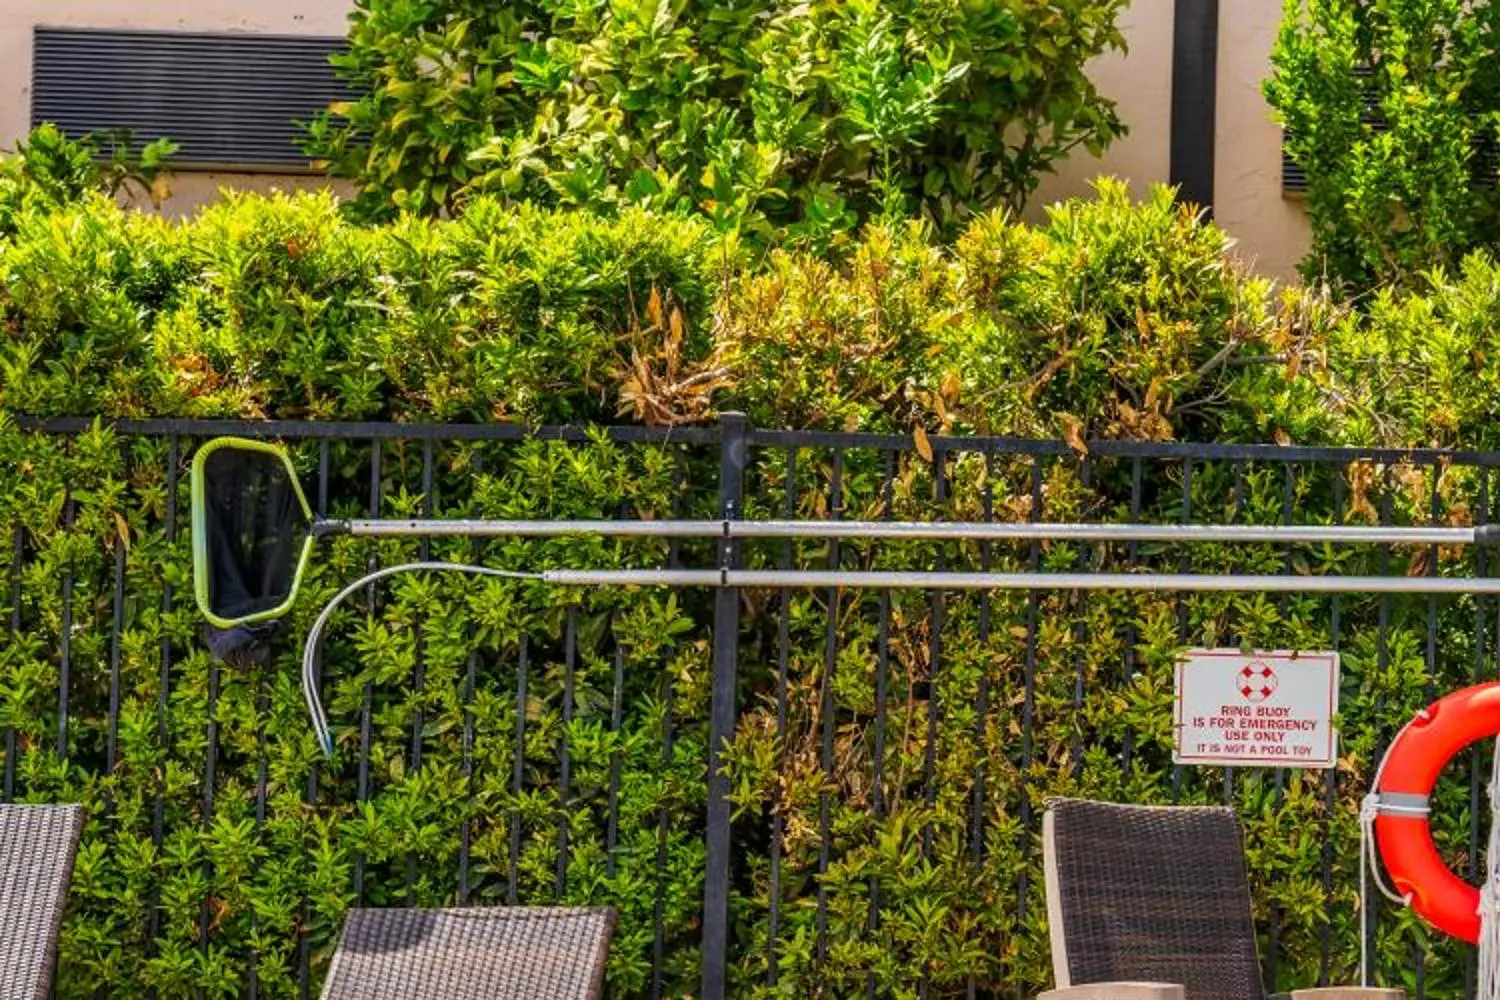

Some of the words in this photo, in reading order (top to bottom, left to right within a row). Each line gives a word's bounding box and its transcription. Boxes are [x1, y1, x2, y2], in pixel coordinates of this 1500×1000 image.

[1221, 705, 1251, 716] RING
[1257, 706, 1291, 717] BUOY
[1193, 716, 1205, 728] IS
[1209, 717, 1235, 729] FOR
[1239, 717, 1317, 731] EMERGENCY
[1225, 730, 1249, 741] USE
[1254, 731, 1285, 743] ONLY
[1197, 743, 1206, 753] IT
[1209, 744, 1221, 753] IS
[1224, 744, 1245, 753] NOT
[1250, 745, 1257, 754] A
[1261, 745, 1289, 755] POOL
[1293, 744, 1312, 756] TOY
